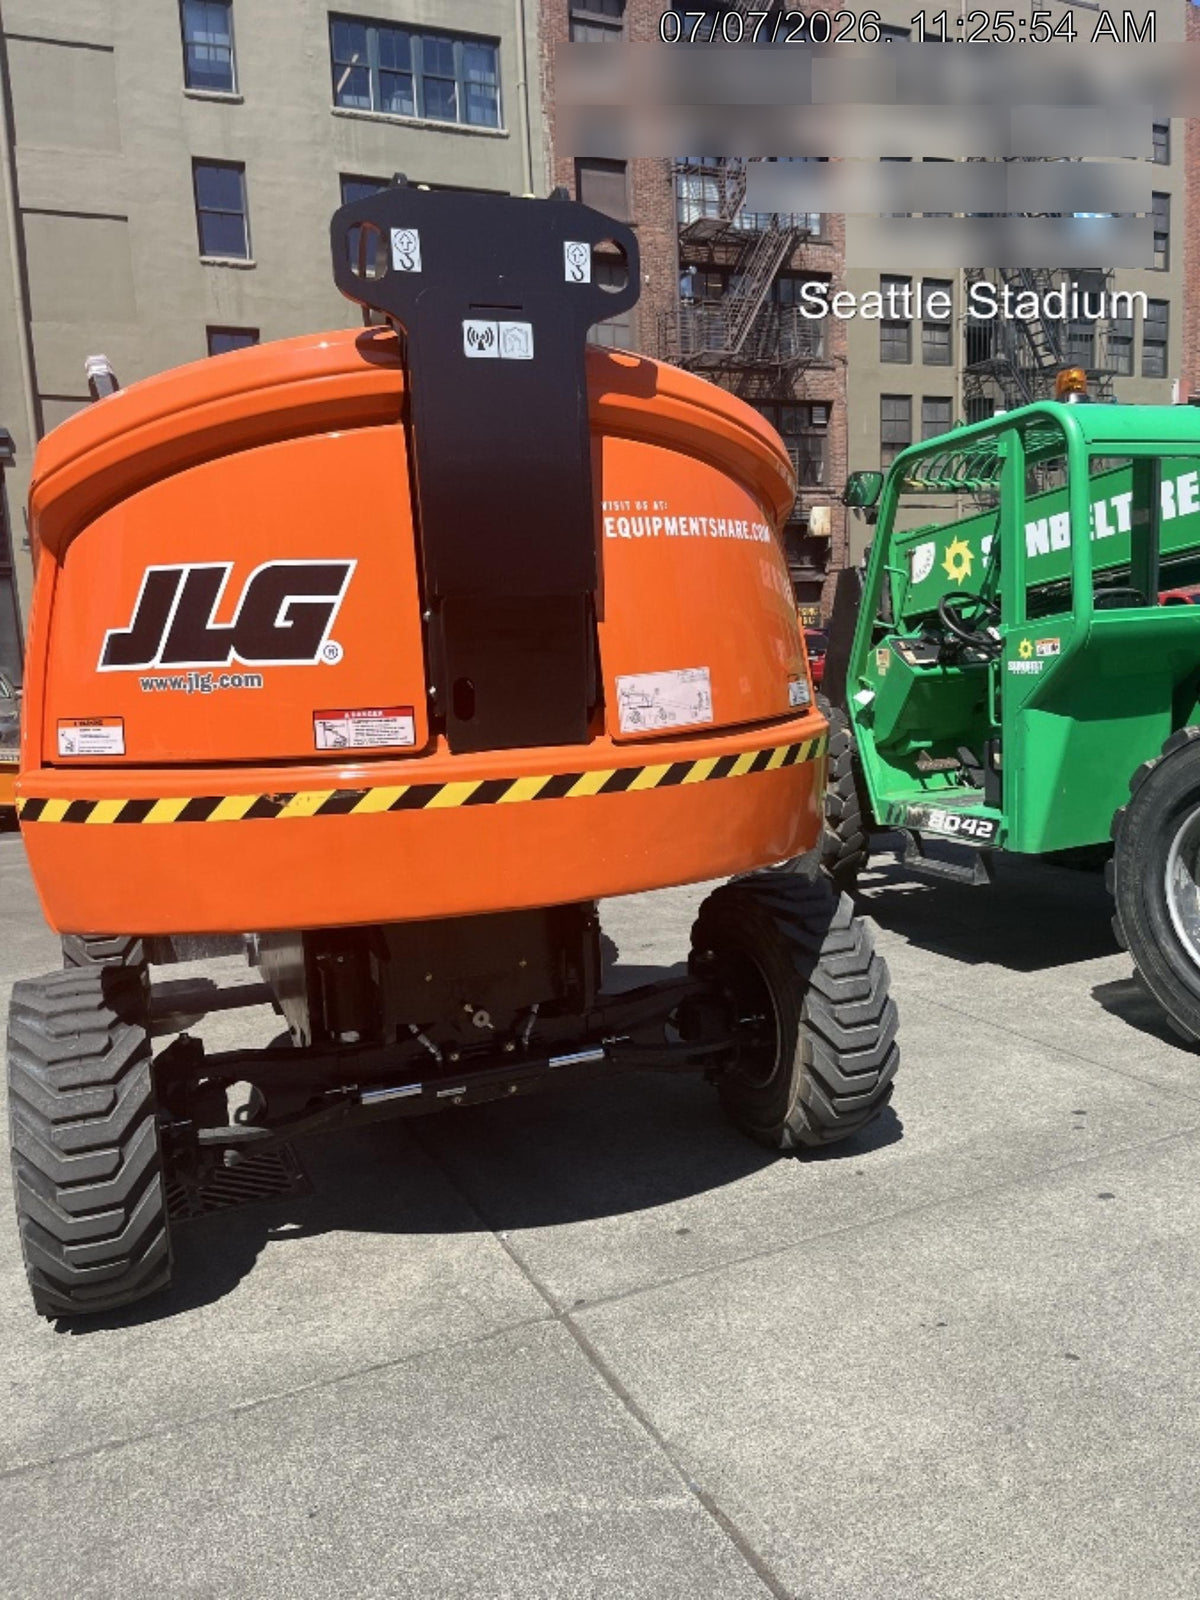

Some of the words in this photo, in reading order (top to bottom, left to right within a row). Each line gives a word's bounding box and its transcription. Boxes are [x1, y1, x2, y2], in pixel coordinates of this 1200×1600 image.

[604, 516, 770, 543] EQUIPMENTSHARE.COM
[981, 491, 1133, 568] NBLT
[140, 672, 264, 694] www.jlg.com
[928, 807, 993, 838] 8042
